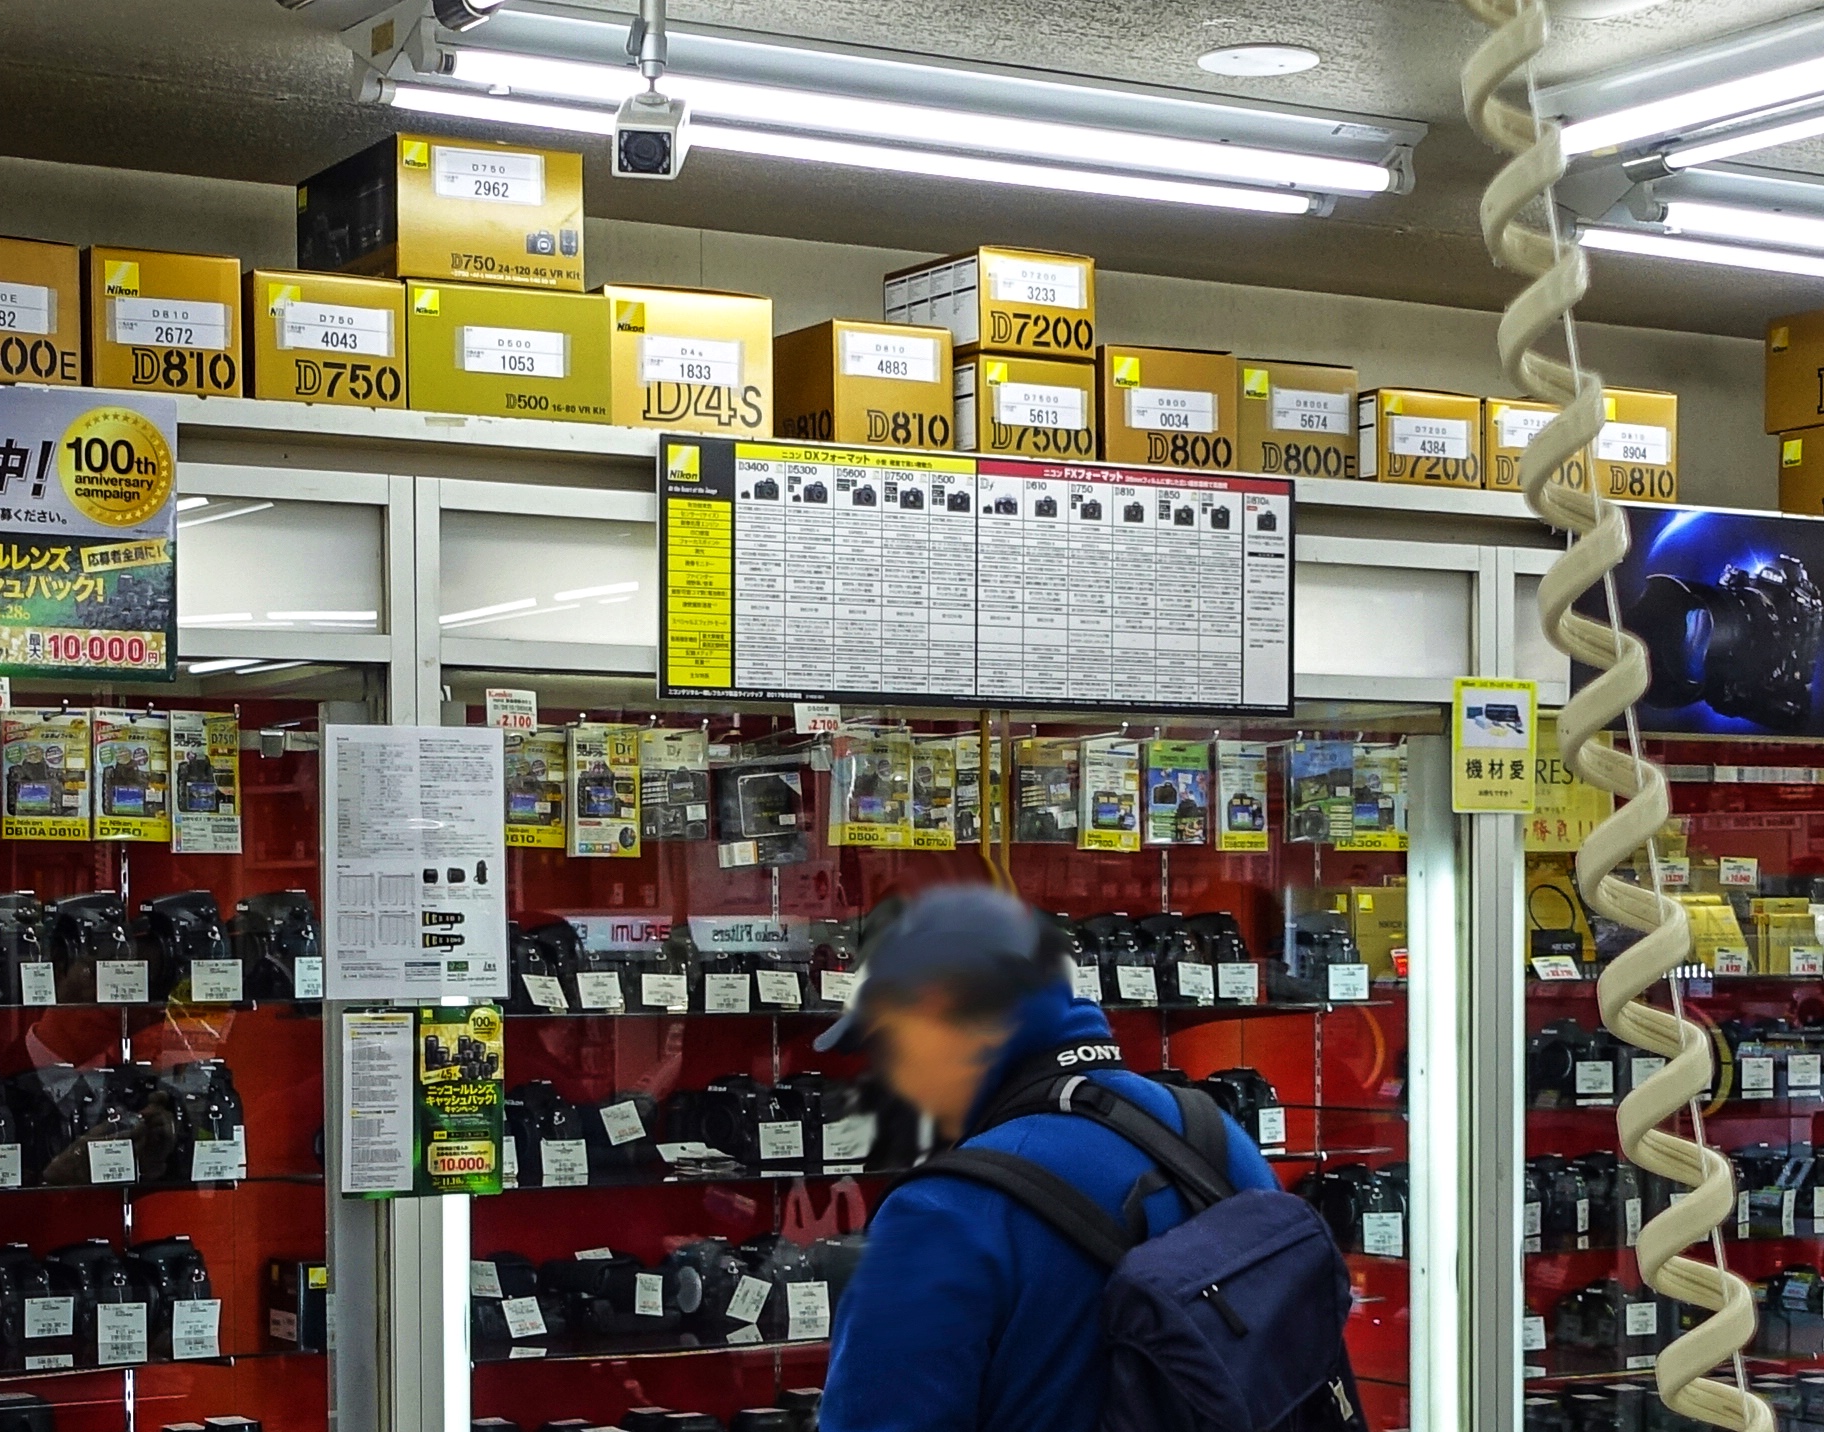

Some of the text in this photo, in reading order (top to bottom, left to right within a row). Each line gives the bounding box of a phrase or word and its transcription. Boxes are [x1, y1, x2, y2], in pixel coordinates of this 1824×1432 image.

[473, 180, 509, 198] 2962
[451, 253, 495, 271] D750
[497, 263, 530, 276] 24-120
[564, 269, 581, 280] Kit
[106, 285, 138, 296] Nikon
[1026, 287, 1056, 302] 3233
[154, 327, 193, 345] 2672
[616, 322, 644, 333] Nikon
[991, 311, 1093, 351] D7200
[320, 332, 357, 350] 4043
[131, 348, 235, 391] D810
[500, 355, 535, 372] 1053
[678, 364, 711, 380] 1833
[876, 360, 908, 376] 4883
[294, 359, 400, 401] D750
[505, 394, 548, 411] D500
[642, 379, 763, 427] D4s
[1028, 409, 1058, 424] 5613
[1159, 413, 1189, 428] 0034
[1299, 414, 1328, 429] 5674
[866, 409, 949, 447] D810
[991, 417, 1093, 455] D7500
[66, 436, 156, 476] 100th
[1147, 433, 1232, 468] D800
[1419, 440, 1446, 455] 4384
[1622, 445, 1647, 460] 8904
[803, 450, 870, 463] DXフォーマット
[1261, 441, 1355, 478] D800E
[669, 470, 698, 480] Nikon
[737, 462, 769, 472] D3400
[787, 465, 817, 475] D5300
[836, 468, 866, 478] D5600
[1063, 468, 1123, 482] FXフォーマット
[74, 474, 153, 491] anniversary
[884, 471, 913, 482] D7500
[930, 475, 955, 484] D500
[1609, 467, 1674, 498] D810
[74, 485, 141, 502] campaign
[1465, 758, 1524, 780] 機材愛
[1056, 1043, 1122, 1067] SONY
[427, 1084, 495, 1095] ニッコールレンズ
